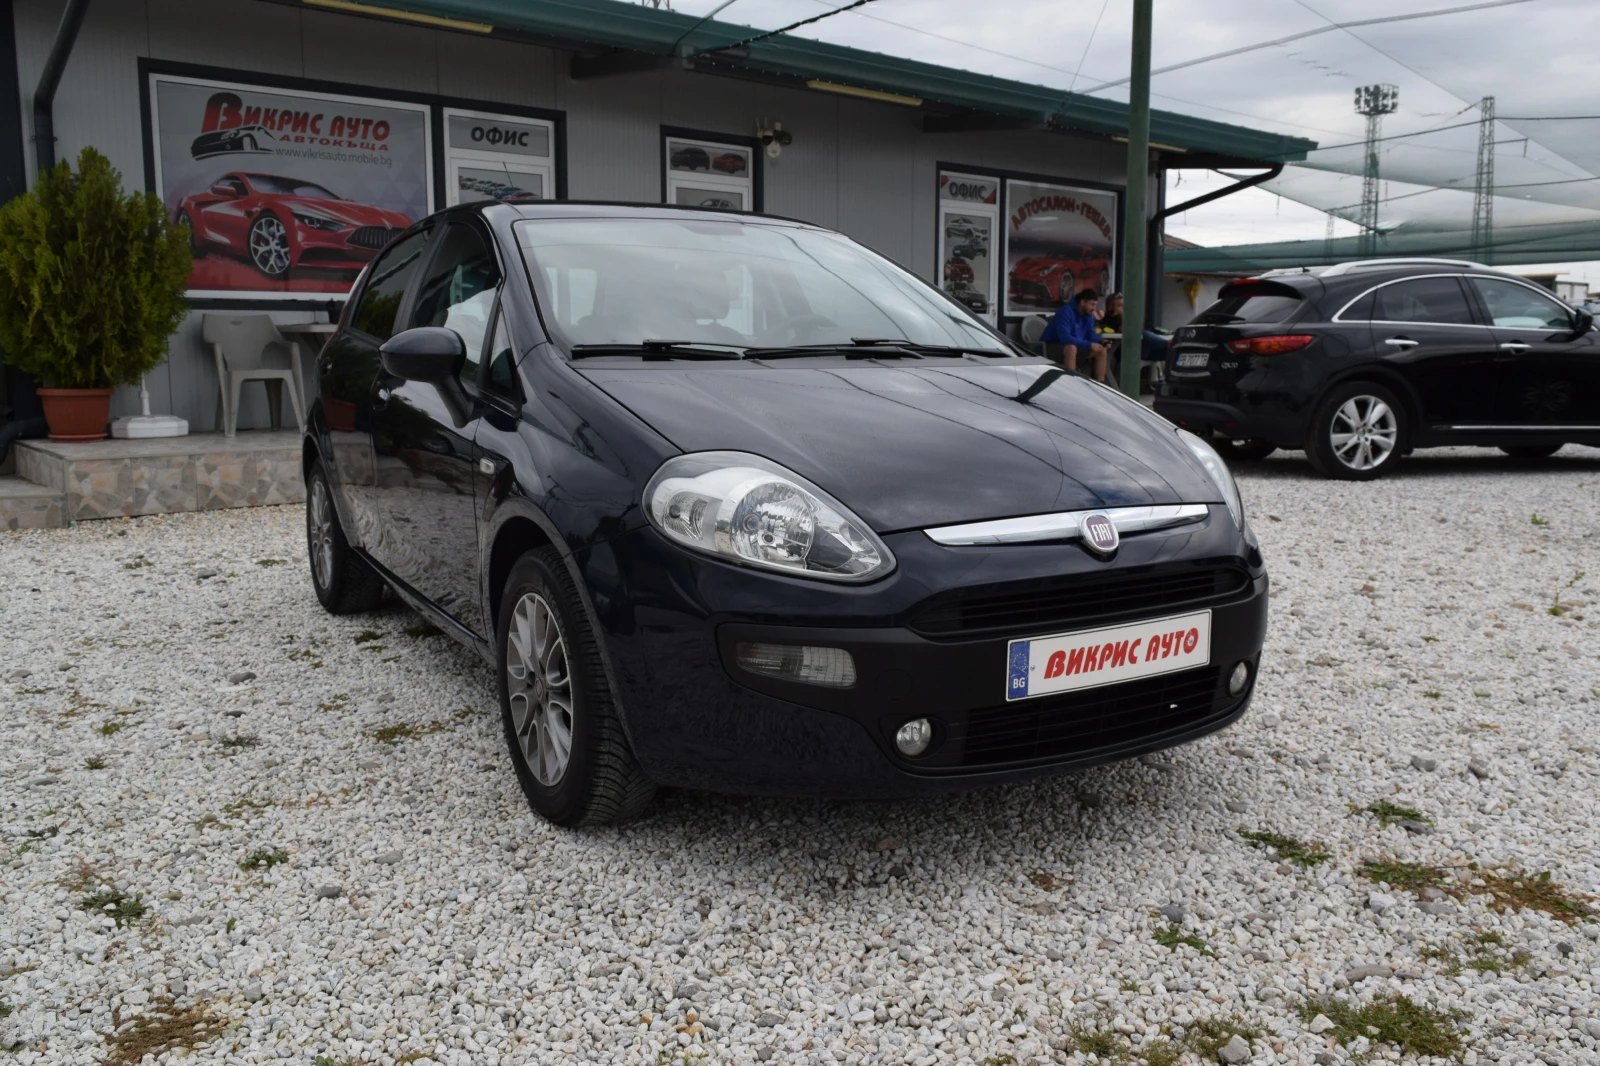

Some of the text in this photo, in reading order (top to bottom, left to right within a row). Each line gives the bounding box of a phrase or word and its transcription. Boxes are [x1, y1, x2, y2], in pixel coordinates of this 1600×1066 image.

[201, 92, 391, 141] ВИКРИС АУТО
[279, 134, 389, 151] АВТОКЪЩА
[471, 126, 530, 147] ОФИС
[275, 147, 393, 168] www.vikrisauto.mobile.bg
[949, 182, 987, 200] ОФИС
[1090, 523, 1114, 542] FIAT
[1043, 627, 1199, 680] ВИКРИС АУТО
[1012, 677, 1026, 689] BG
